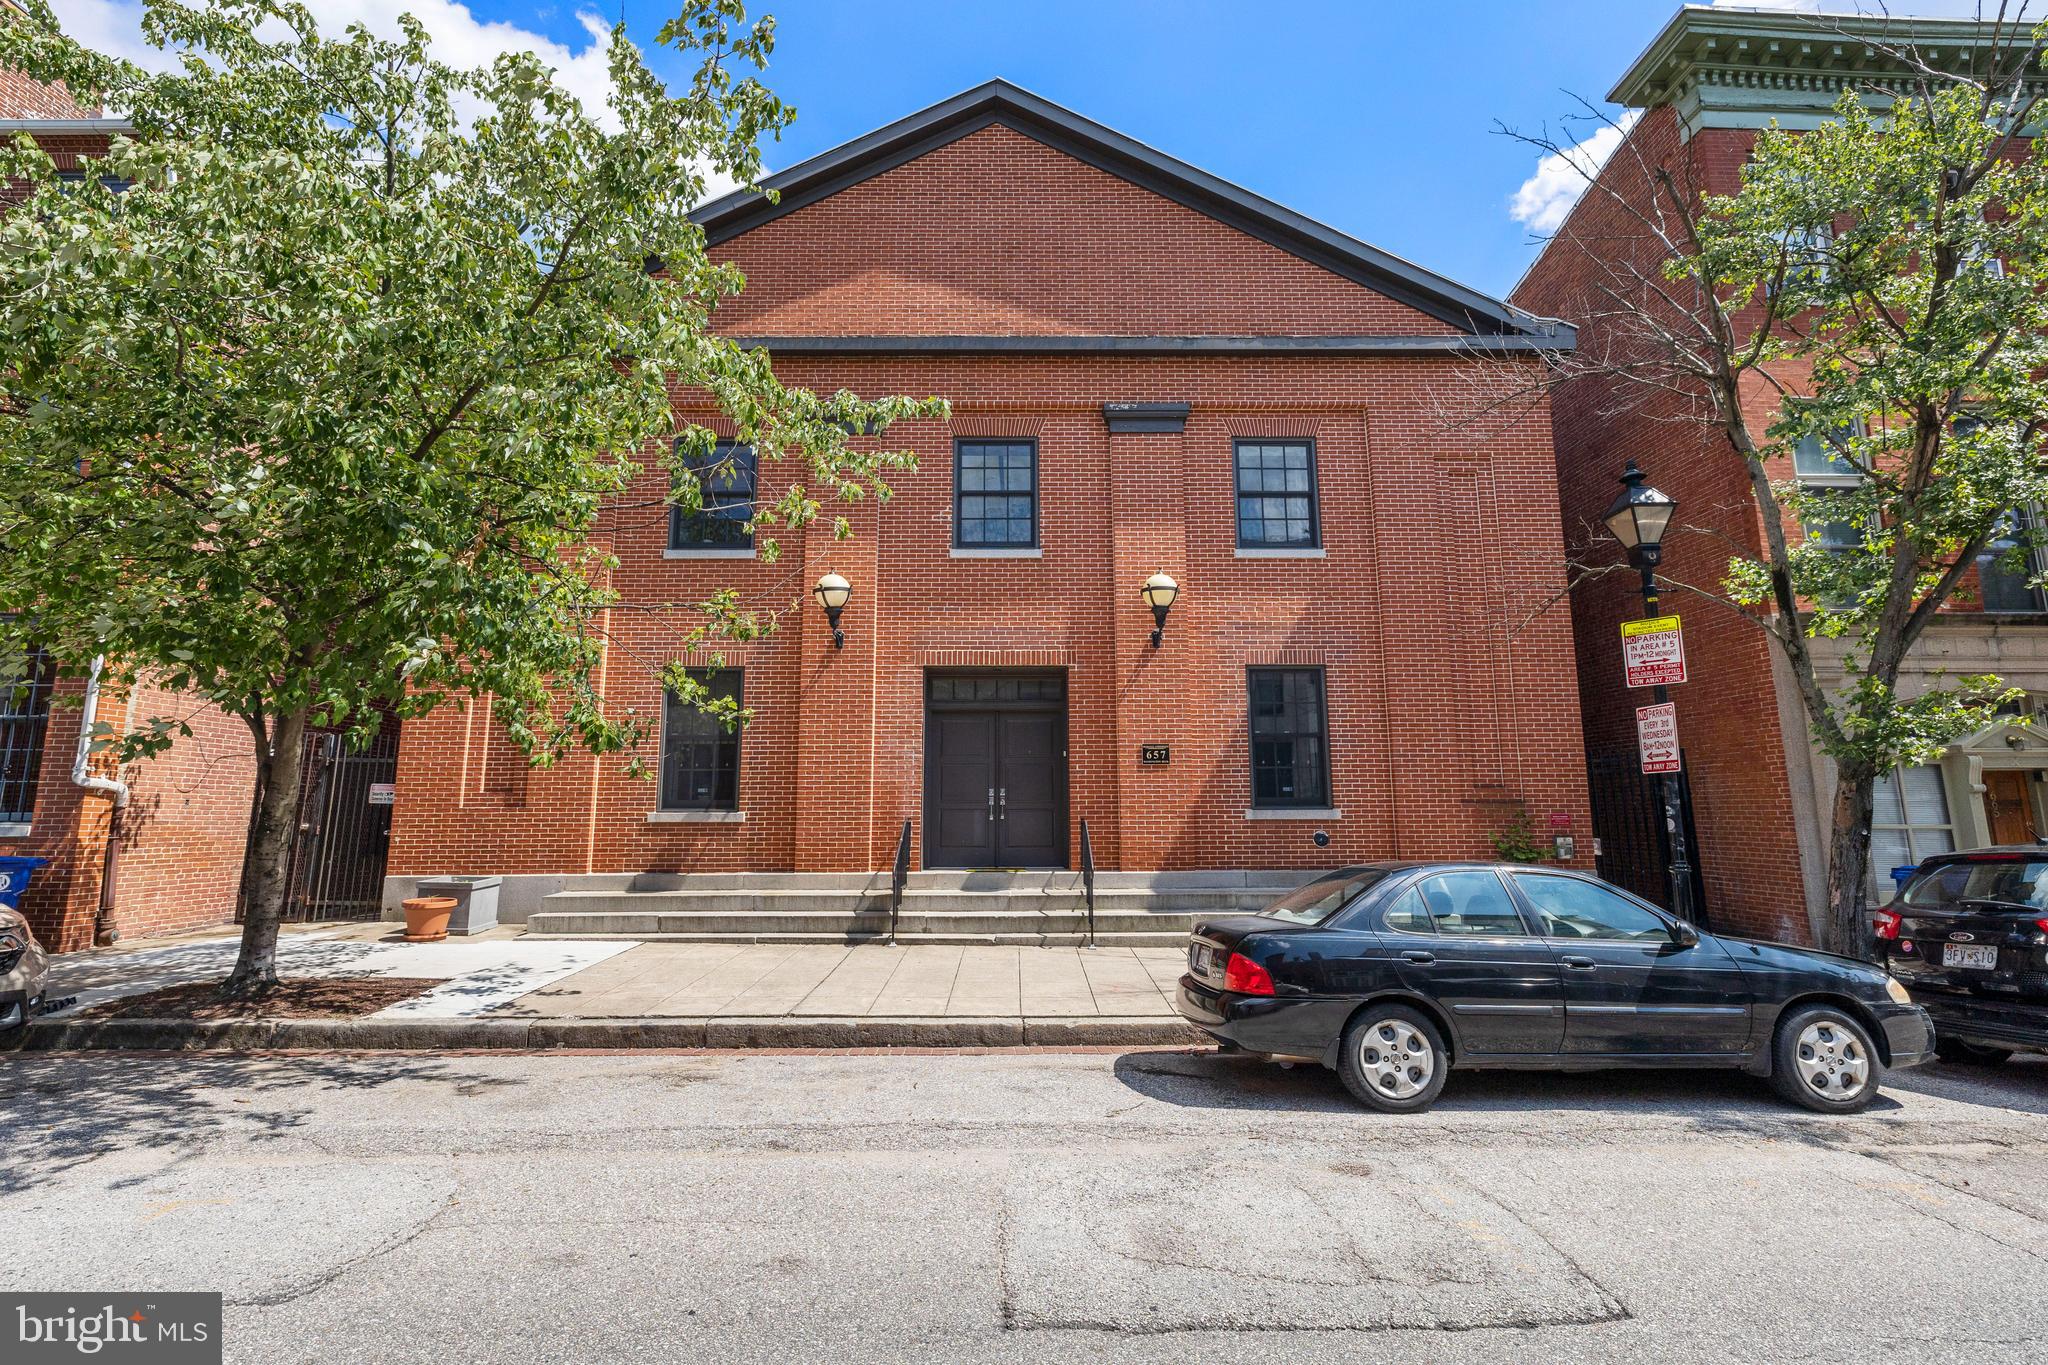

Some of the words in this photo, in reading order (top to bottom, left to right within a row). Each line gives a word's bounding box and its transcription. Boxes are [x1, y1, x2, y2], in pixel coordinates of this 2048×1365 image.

[1637, 632, 1677, 643] PARKING
[1631, 651, 1654, 660] 1PM-12
[1655, 649, 1677, 657] MIDNIGHT
[1638, 710, 1648, 720] NO
[1648, 707, 1672, 719] PARKING
[1644, 721, 1658, 729] EVERY
[1661, 719, 1669, 728] 3rd
[1642, 729, 1673, 739] WEDNESDAY
[1146, 750, 1166, 759] 657
[1666, 761, 1679, 769] ZONE
